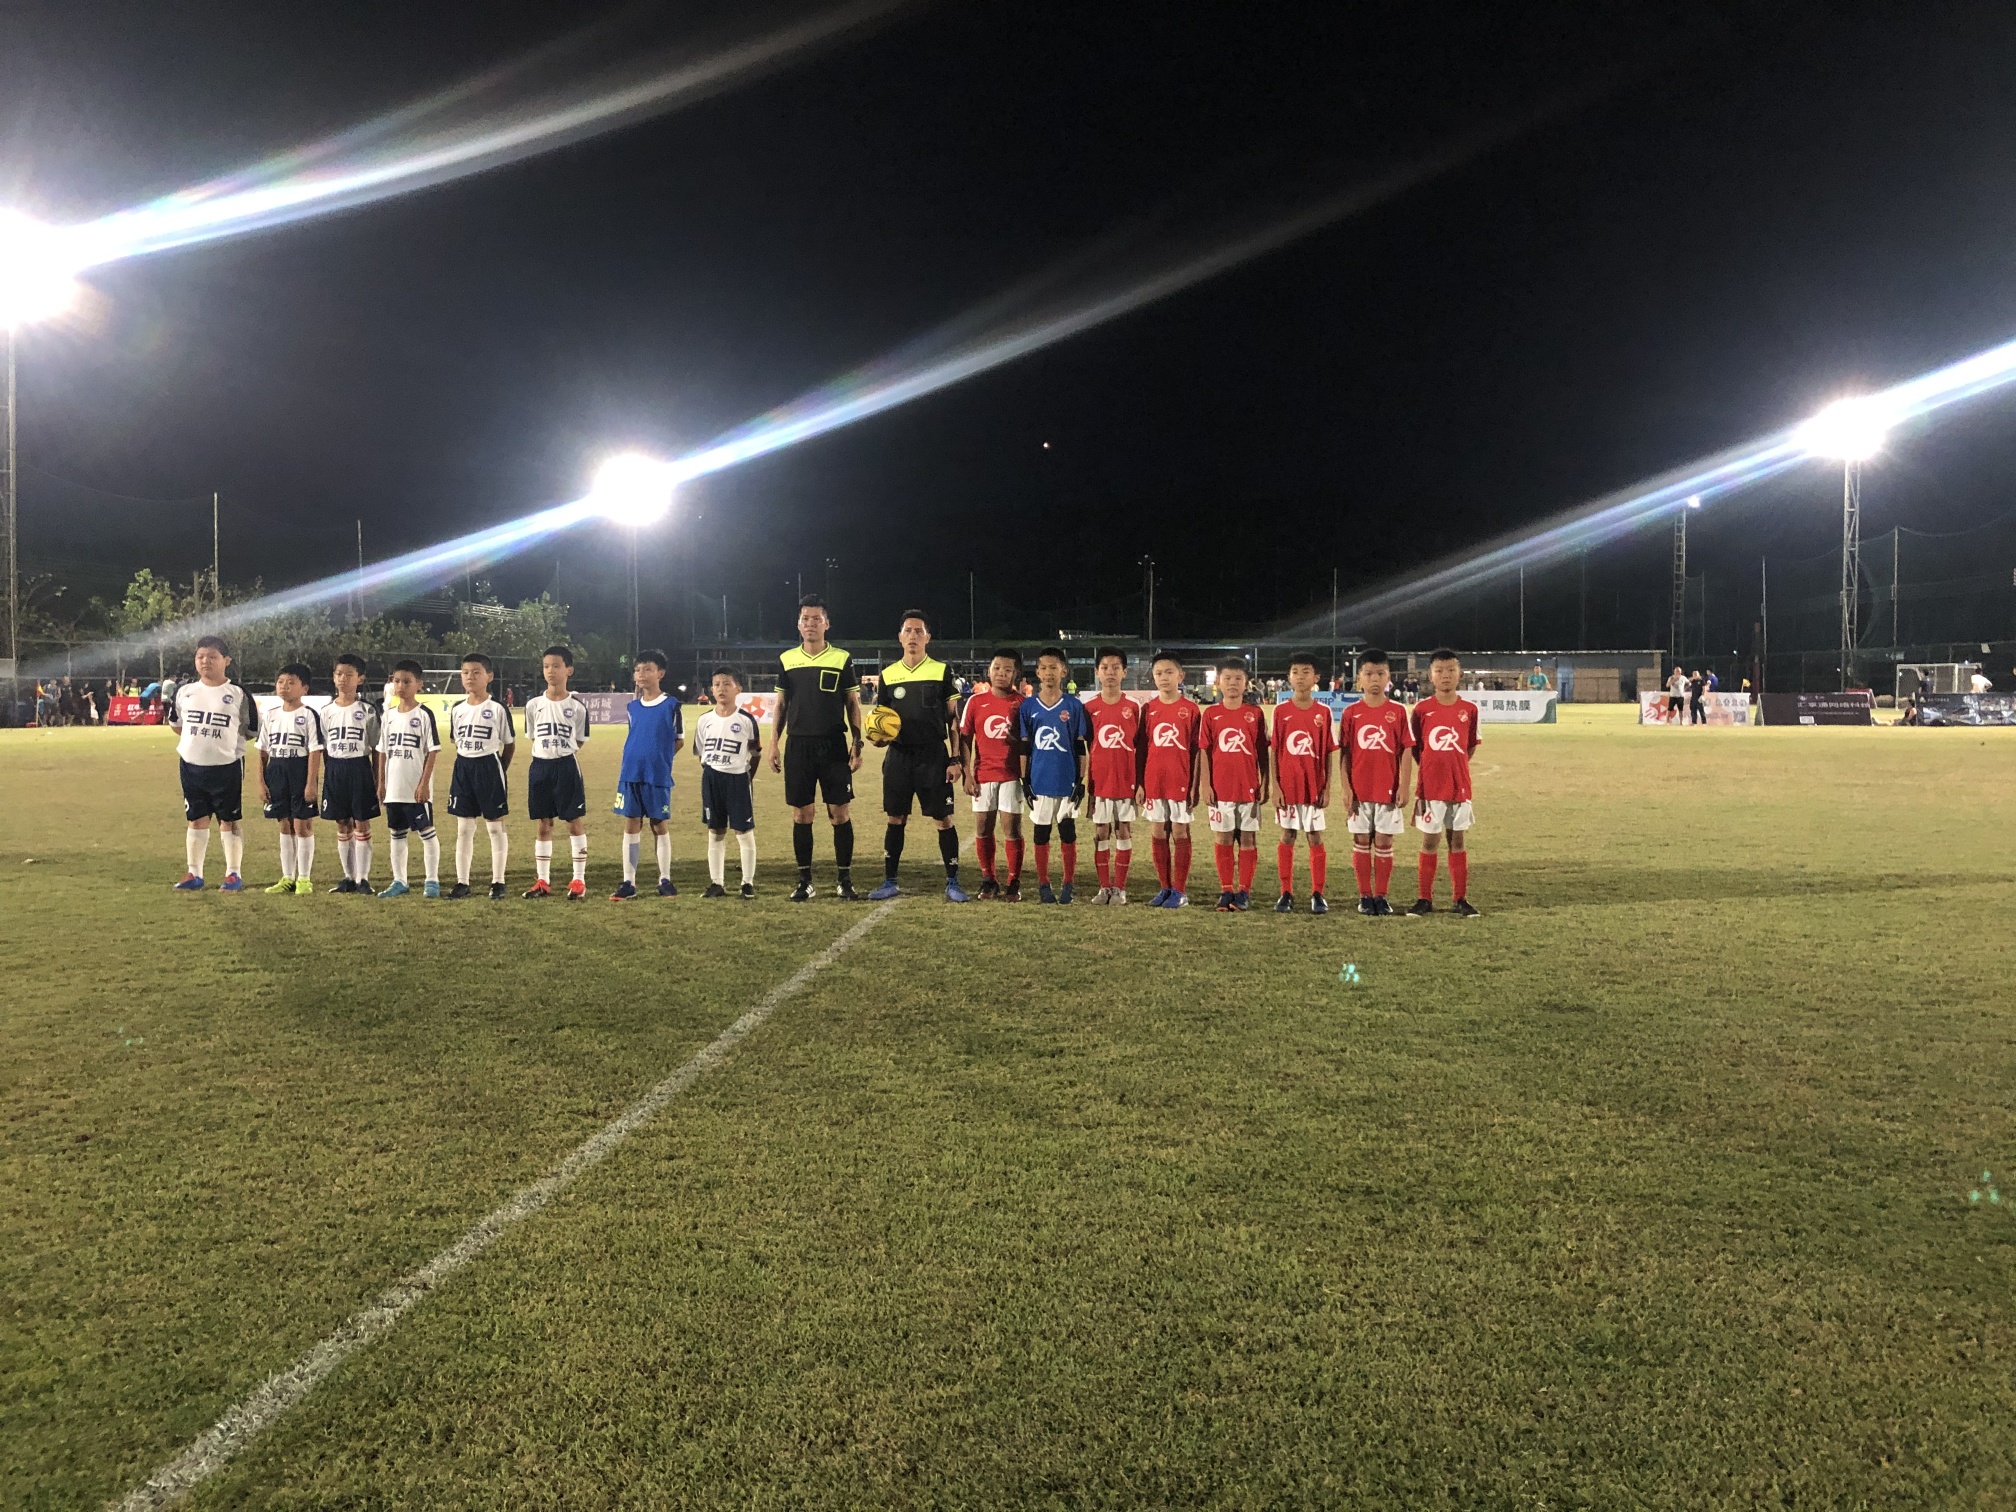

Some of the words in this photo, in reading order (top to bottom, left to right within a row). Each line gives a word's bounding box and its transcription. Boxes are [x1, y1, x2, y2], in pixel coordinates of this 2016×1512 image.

[190, 725, 222, 739] 青年队
[541, 738, 571, 749] 青年队
[1209, 808, 1222, 823] 20
